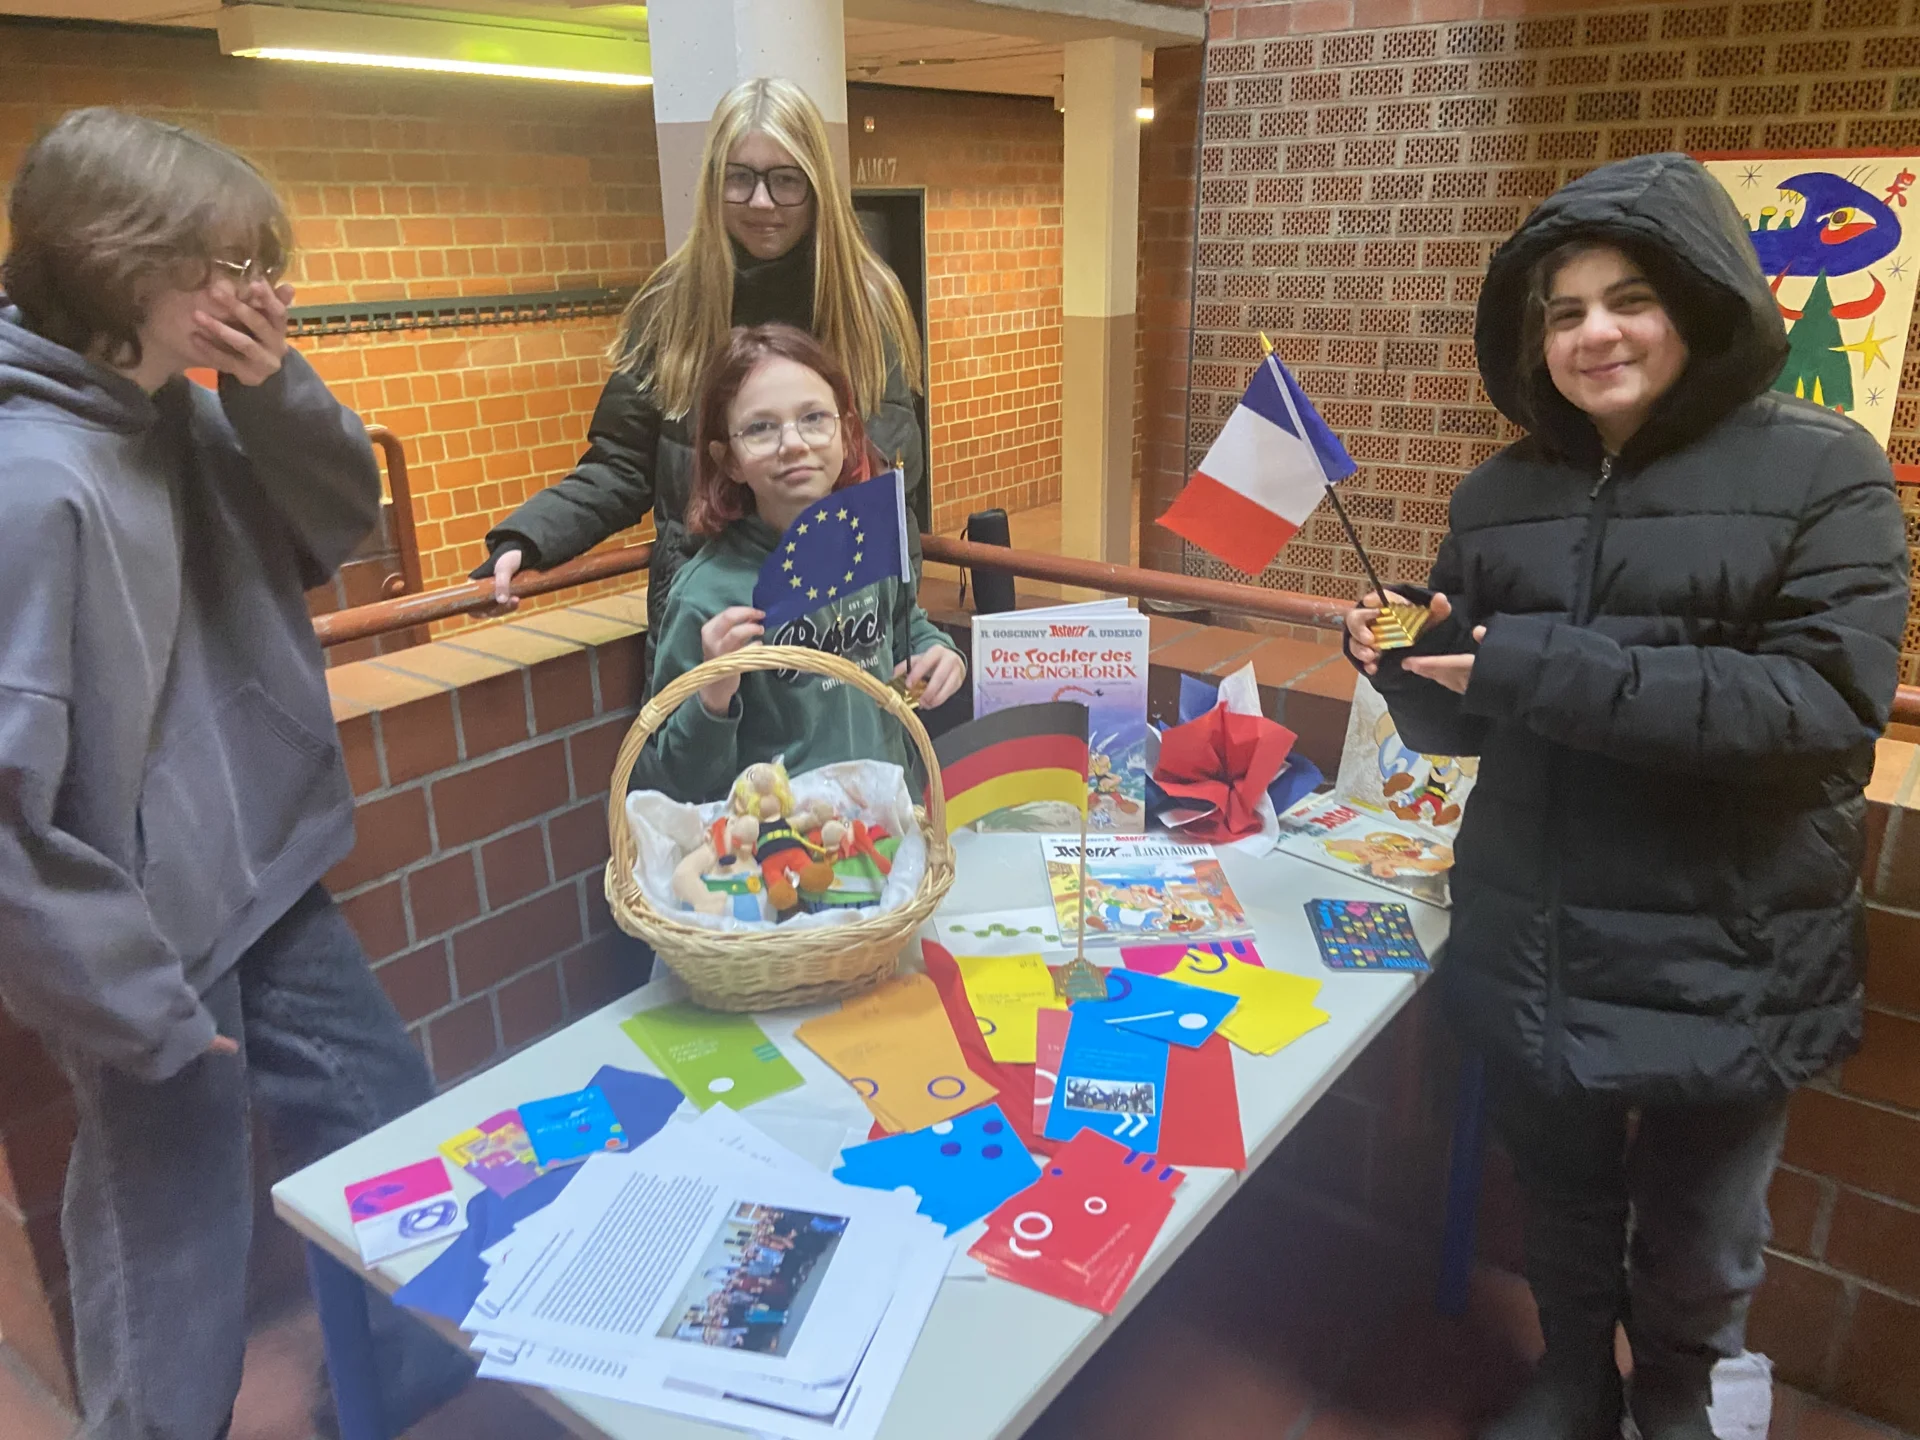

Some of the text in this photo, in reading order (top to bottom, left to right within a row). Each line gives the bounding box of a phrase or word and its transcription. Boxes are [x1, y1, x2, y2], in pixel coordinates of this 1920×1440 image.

[993, 629, 1047, 639] GOSCINNY
[1049, 624, 1089, 638] Asterix
[1100, 629, 1143, 638] UDERZO
[991, 647, 1132, 663] Die Tochter des
